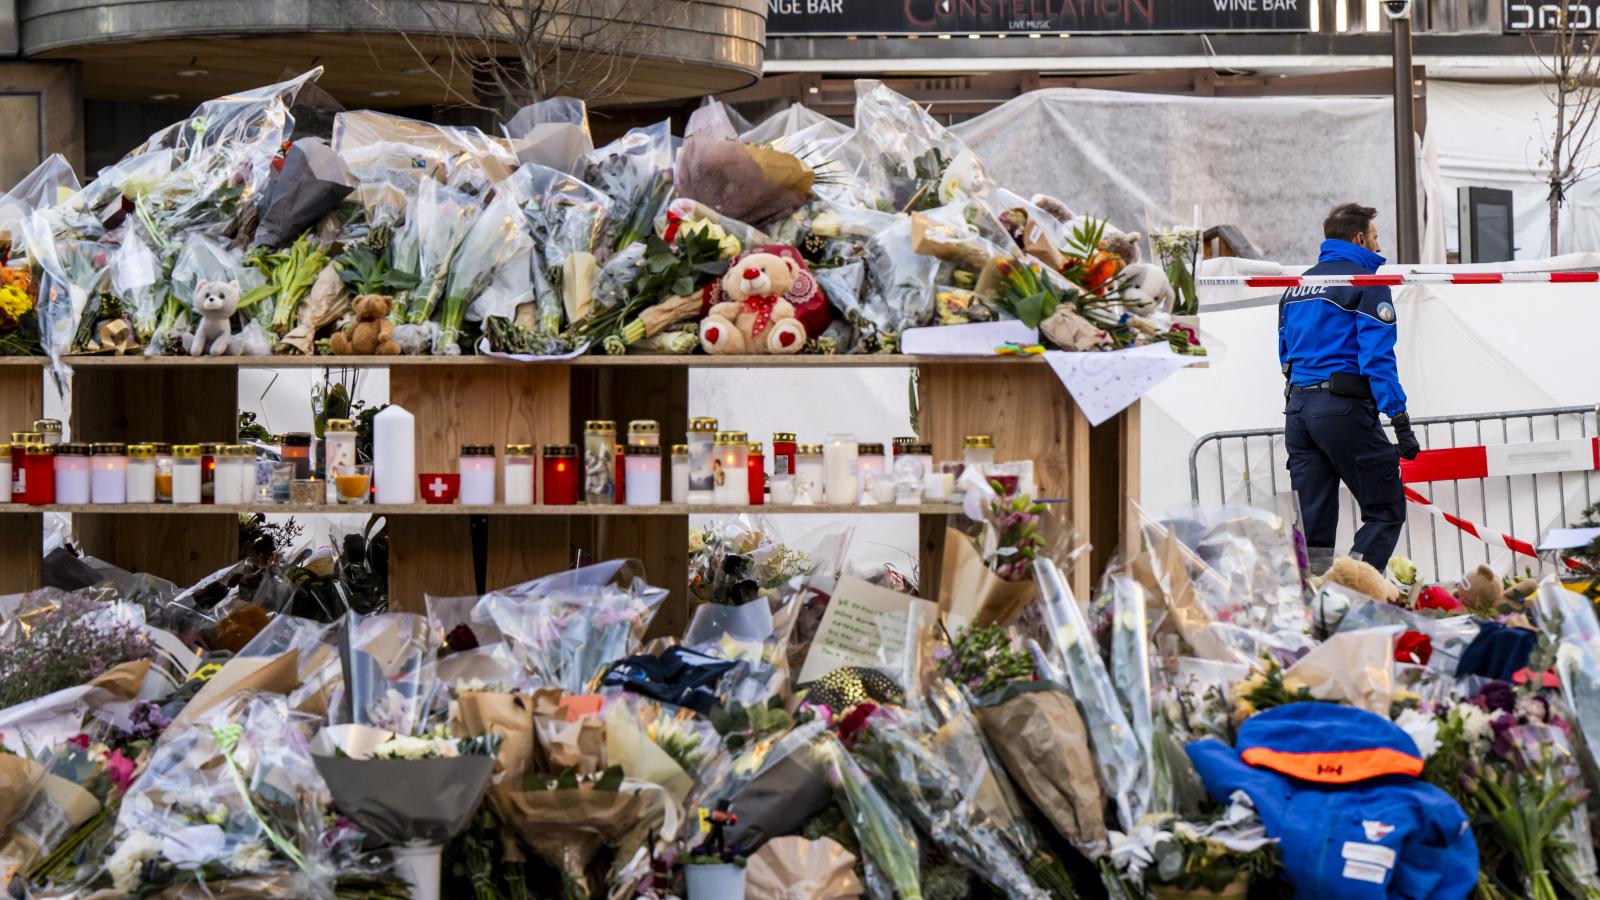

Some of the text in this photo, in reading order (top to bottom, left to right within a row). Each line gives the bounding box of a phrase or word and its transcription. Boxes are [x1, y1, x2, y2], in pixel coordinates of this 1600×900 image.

[807, 0, 843, 14] BAR
[1213, 0, 1298, 11] WINE BAR
[1008, 20, 1051, 29] LIVE MUSIC
